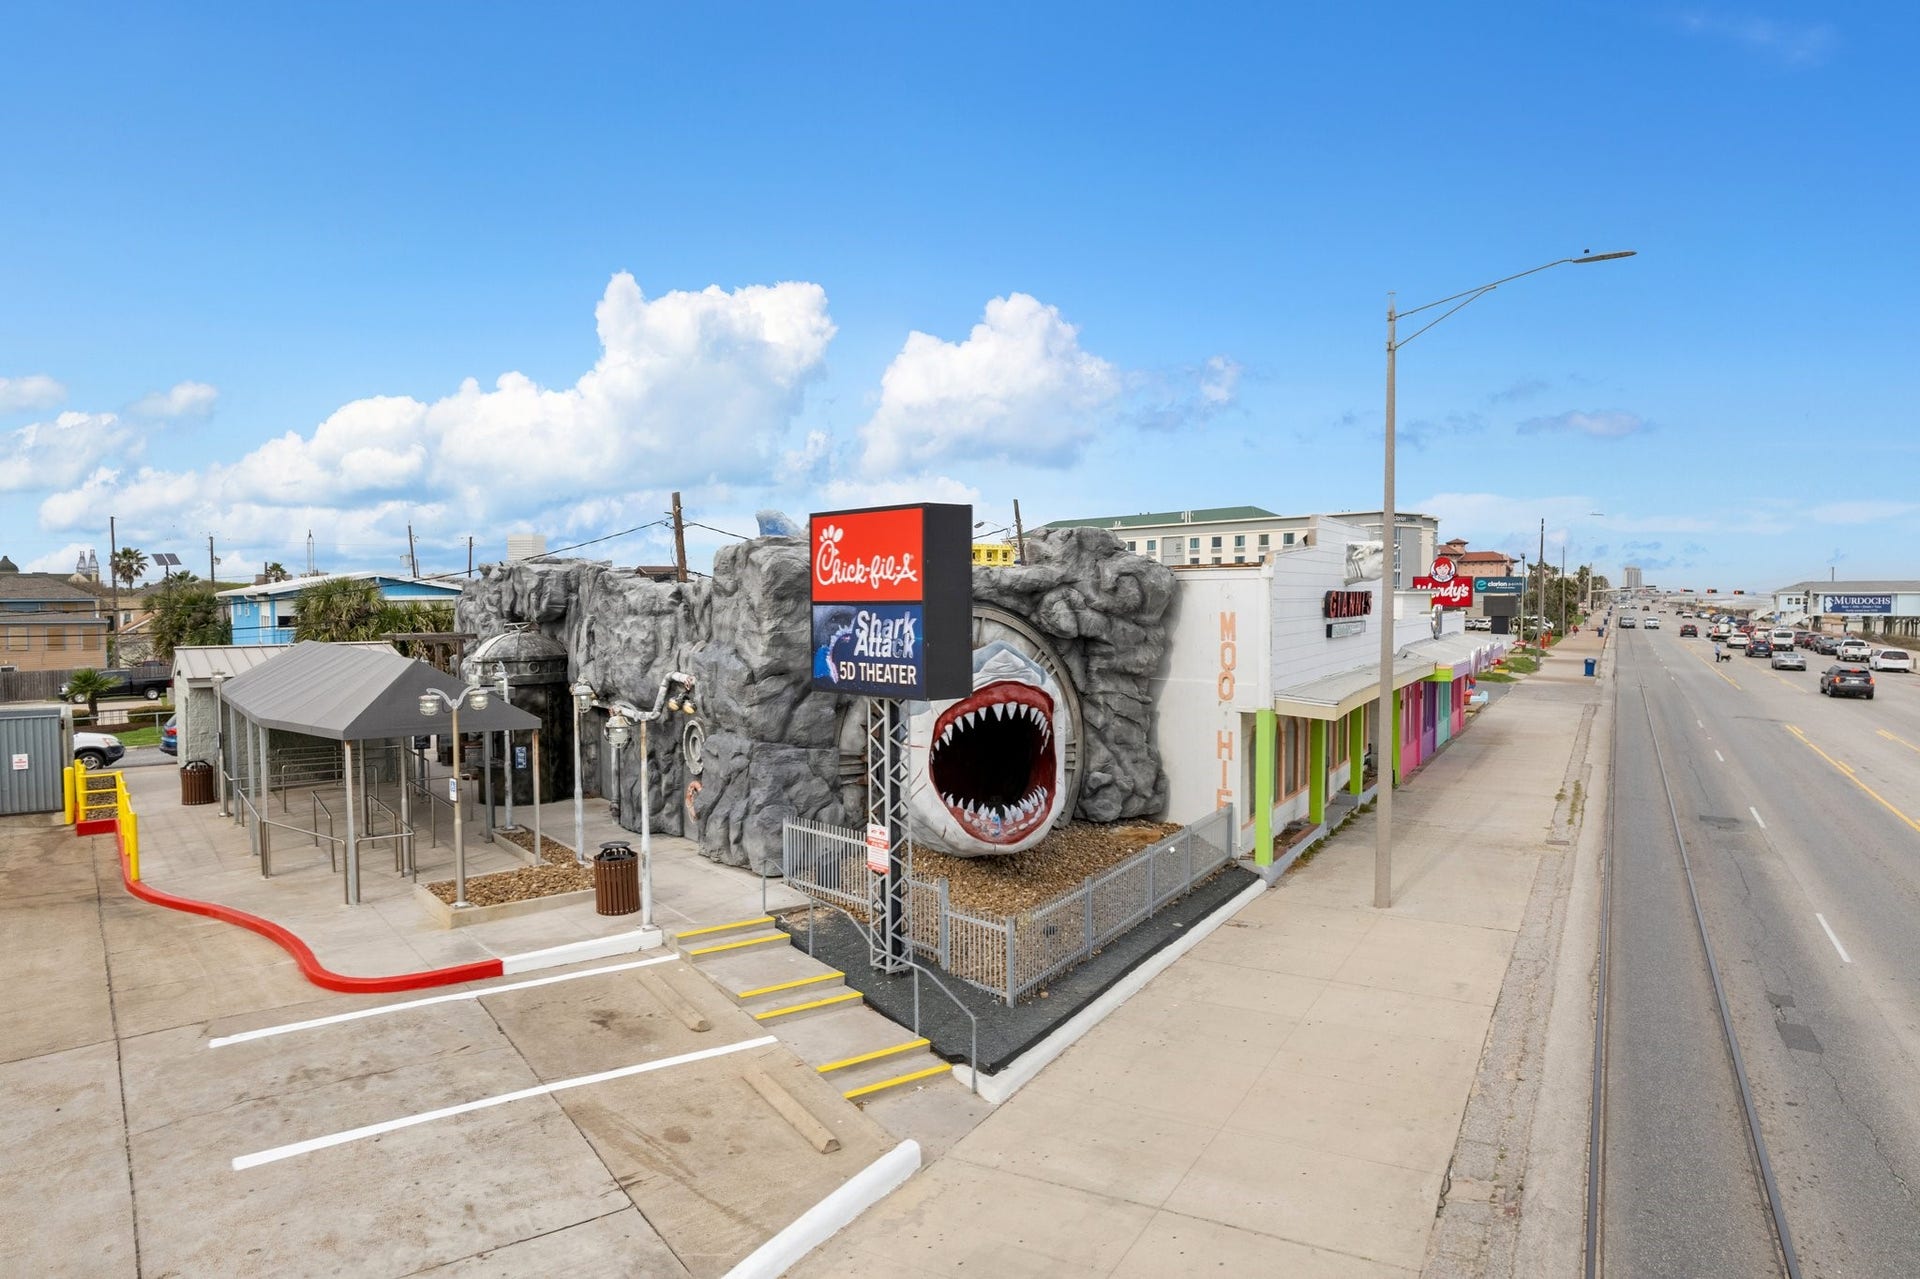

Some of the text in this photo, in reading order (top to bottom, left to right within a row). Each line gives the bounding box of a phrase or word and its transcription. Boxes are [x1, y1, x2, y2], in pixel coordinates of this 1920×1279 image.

[816, 537, 918, 589] Chick-fil-A
[1834, 596, 1891, 605] MURDOCHS
[855, 610, 917, 640] Shark
[854, 630, 915, 658] Attack
[839, 662, 917, 685] 5D THEATER
